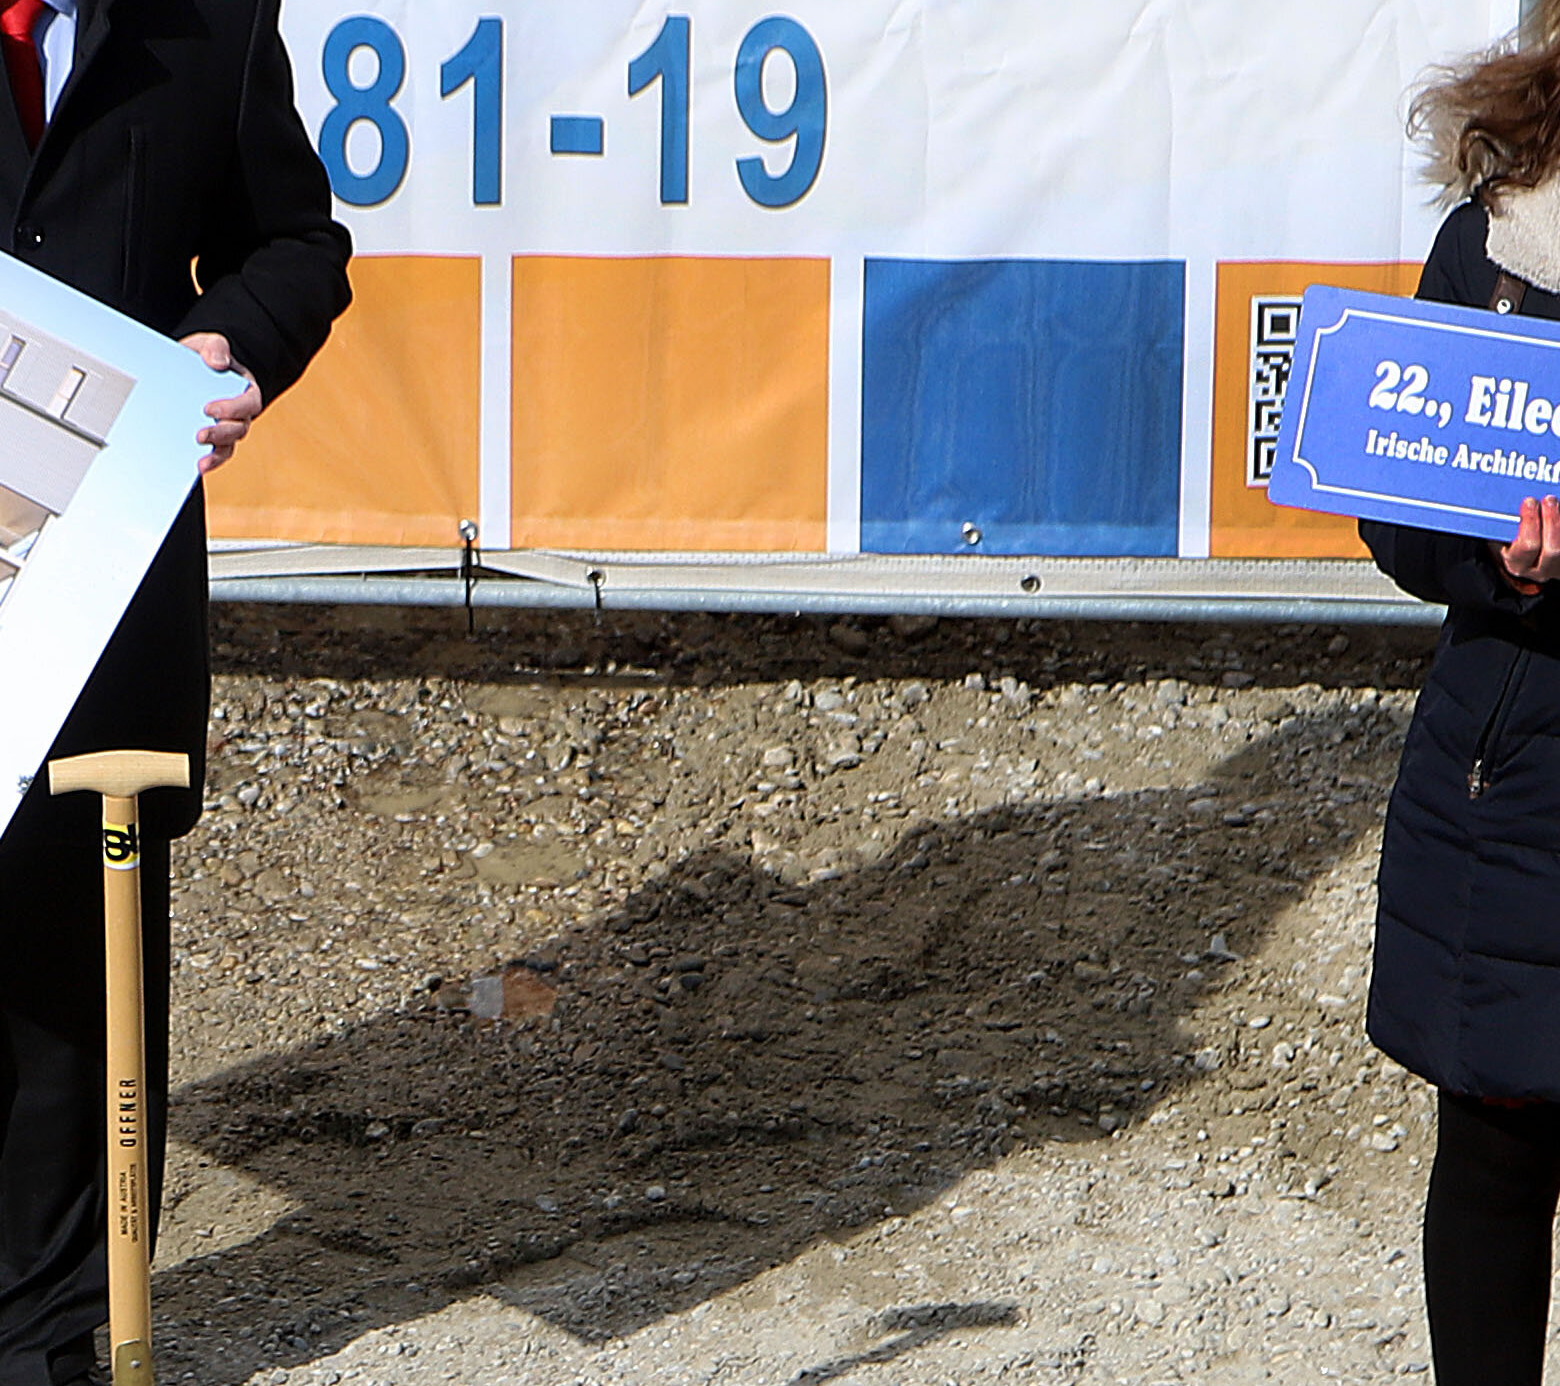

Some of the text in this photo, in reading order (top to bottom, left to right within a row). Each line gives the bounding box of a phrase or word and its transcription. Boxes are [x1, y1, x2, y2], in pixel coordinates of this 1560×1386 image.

[1366, 359, 1454, 429] 22.,
[1364, 427, 1450, 469] Irische
[118, 1078, 137, 1148] OFFNER
